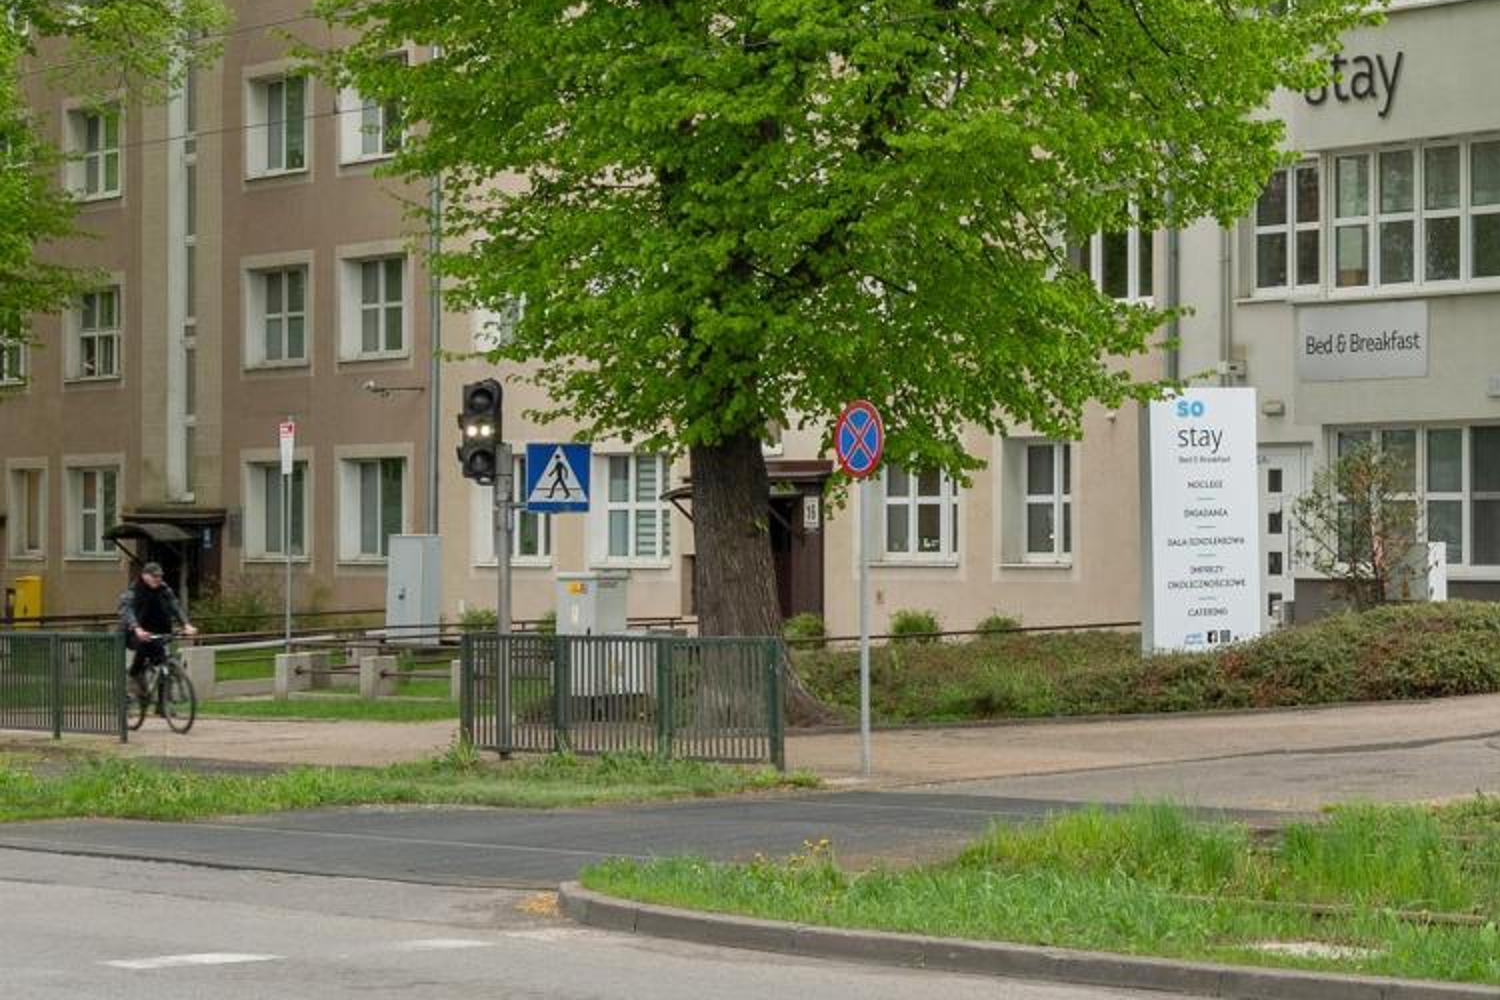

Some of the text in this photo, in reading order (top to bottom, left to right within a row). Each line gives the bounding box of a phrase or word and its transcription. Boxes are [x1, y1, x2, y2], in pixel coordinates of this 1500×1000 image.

[1306, 330, 1421, 355] Bed & Breakfast
[1177, 426, 1223, 454] stay
[1187, 607, 1229, 617] CATERING
